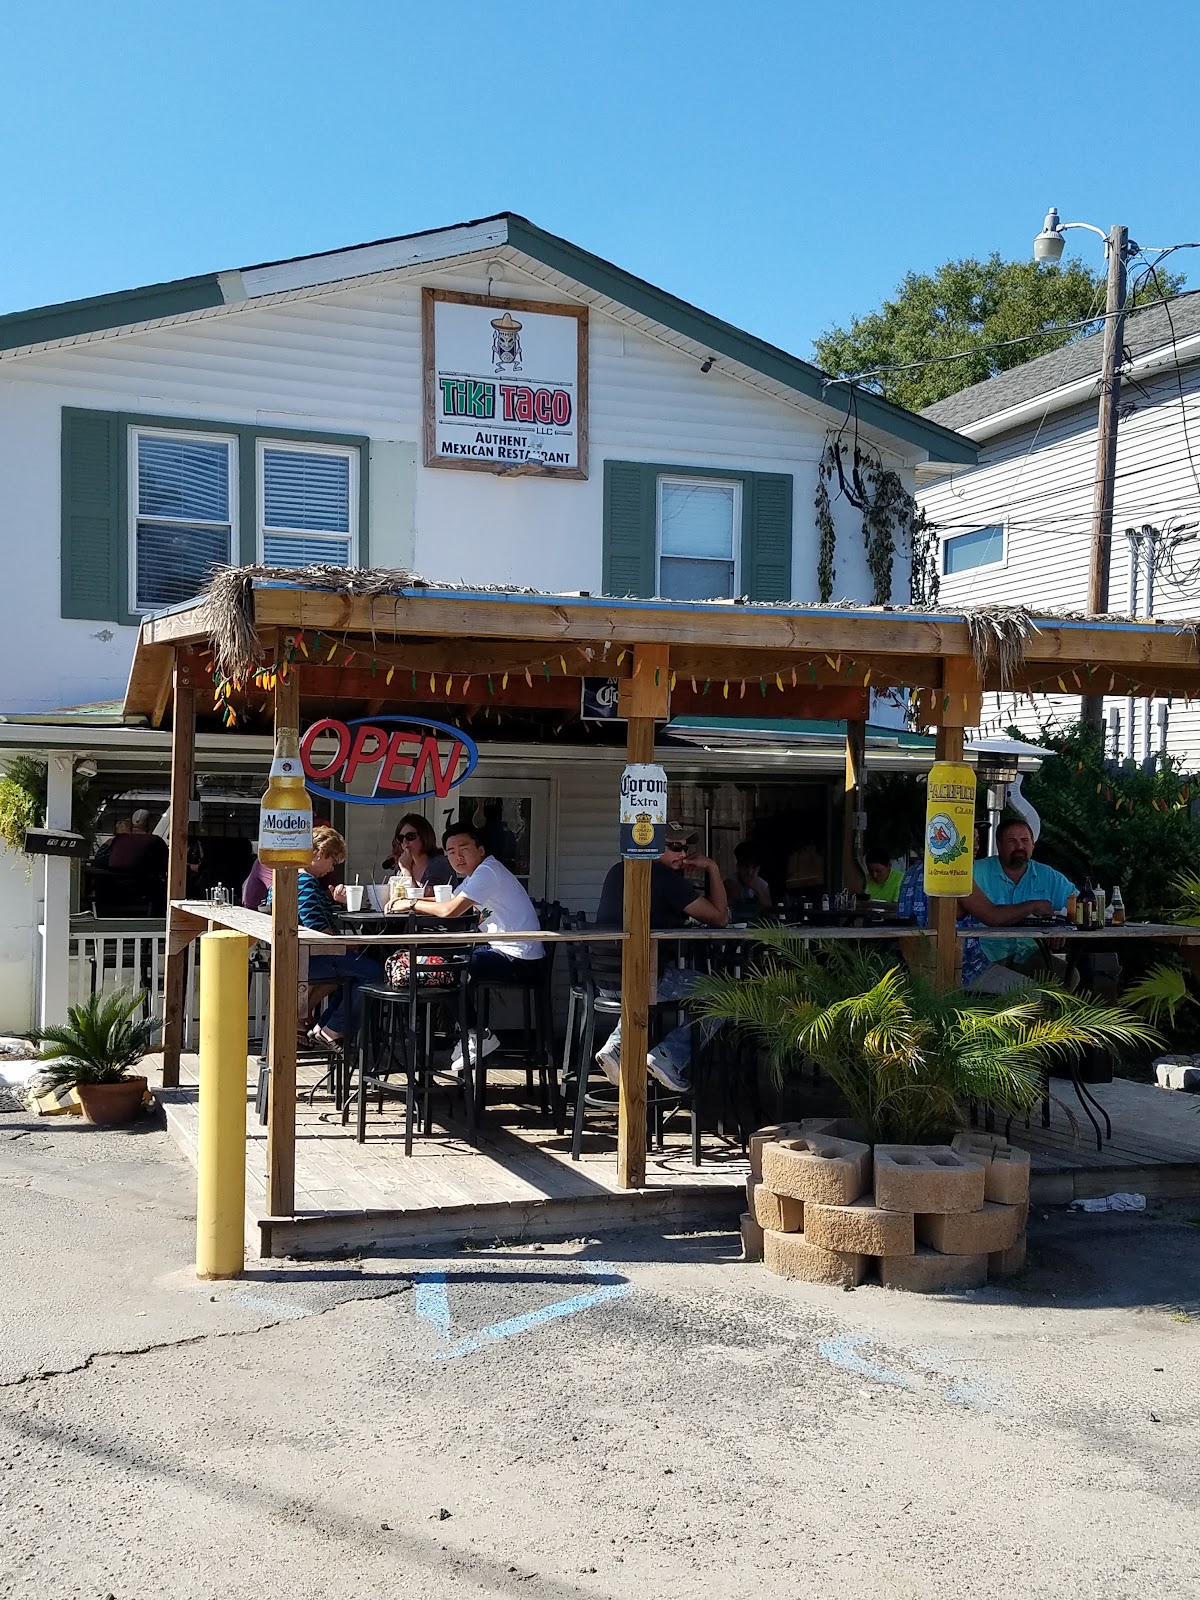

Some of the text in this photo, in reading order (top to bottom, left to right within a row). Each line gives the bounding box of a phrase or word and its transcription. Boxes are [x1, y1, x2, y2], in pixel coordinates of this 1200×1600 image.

[475, 431, 534, 448] AUTHENT
[536, 427, 553, 436] LLC
[441, 441, 571, 464] MEXICAN RESTARANT
[300, 718, 464, 798] OPEN
[630, 794, 658, 807] Extra
[954, 806, 974, 815] CLAR
[267, 814, 306, 830] Modelo
